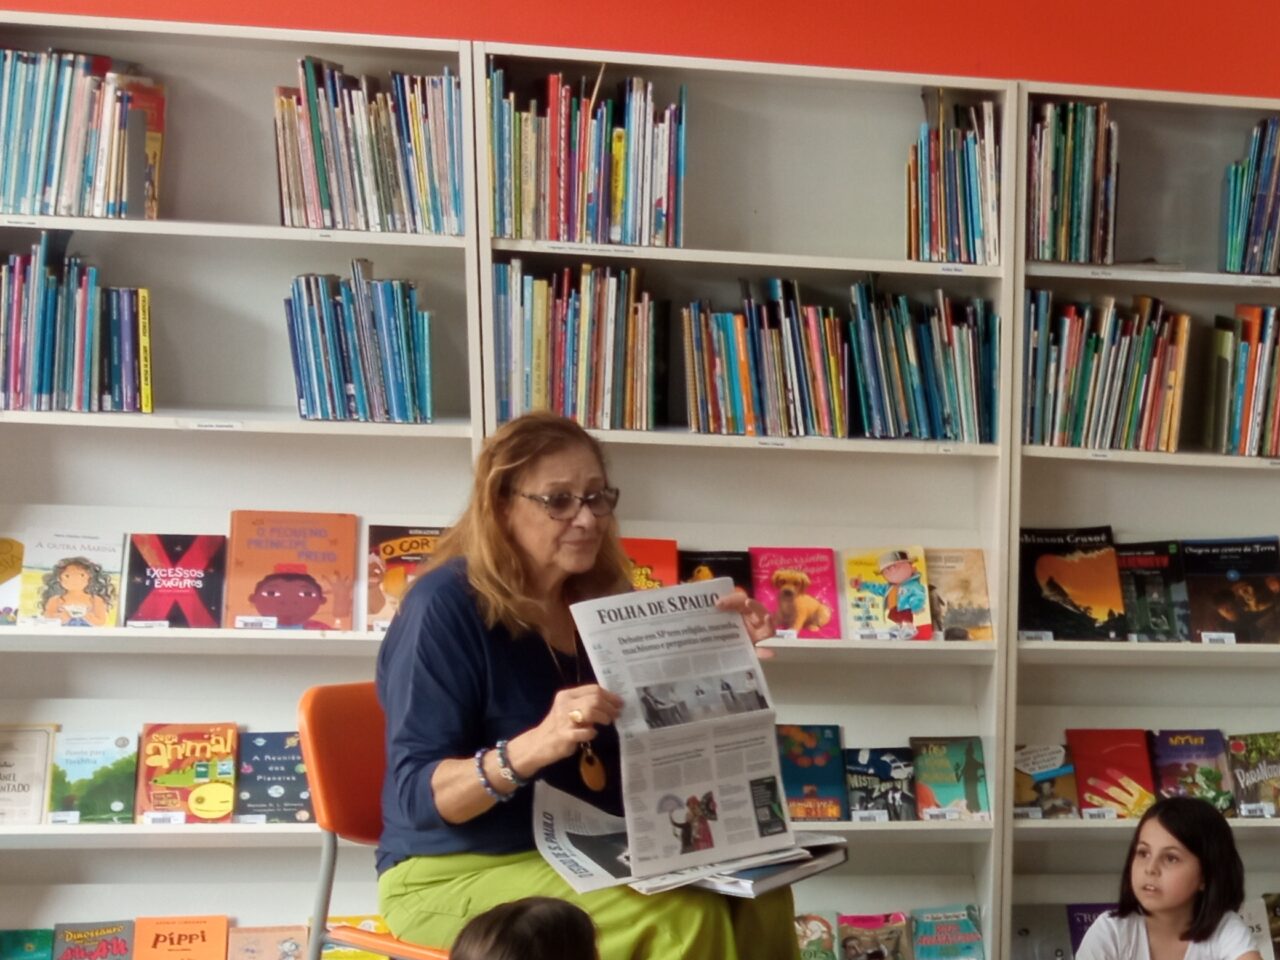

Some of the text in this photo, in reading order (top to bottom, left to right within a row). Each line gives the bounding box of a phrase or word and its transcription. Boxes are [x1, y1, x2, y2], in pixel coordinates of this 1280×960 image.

[270, 527, 328, 538] PEQUENO
[382, 537, 438, 556] O COR
[1252, 544, 1277, 553] Terra
[297, 551, 337, 562] PRETO
[146, 567, 205, 579] EXCESSOS
[598, 605, 648, 624] FOLHA
[649, 600, 667, 616] DE
[145, 729, 234, 768] animal
[542, 811, 558, 843] PAULO
